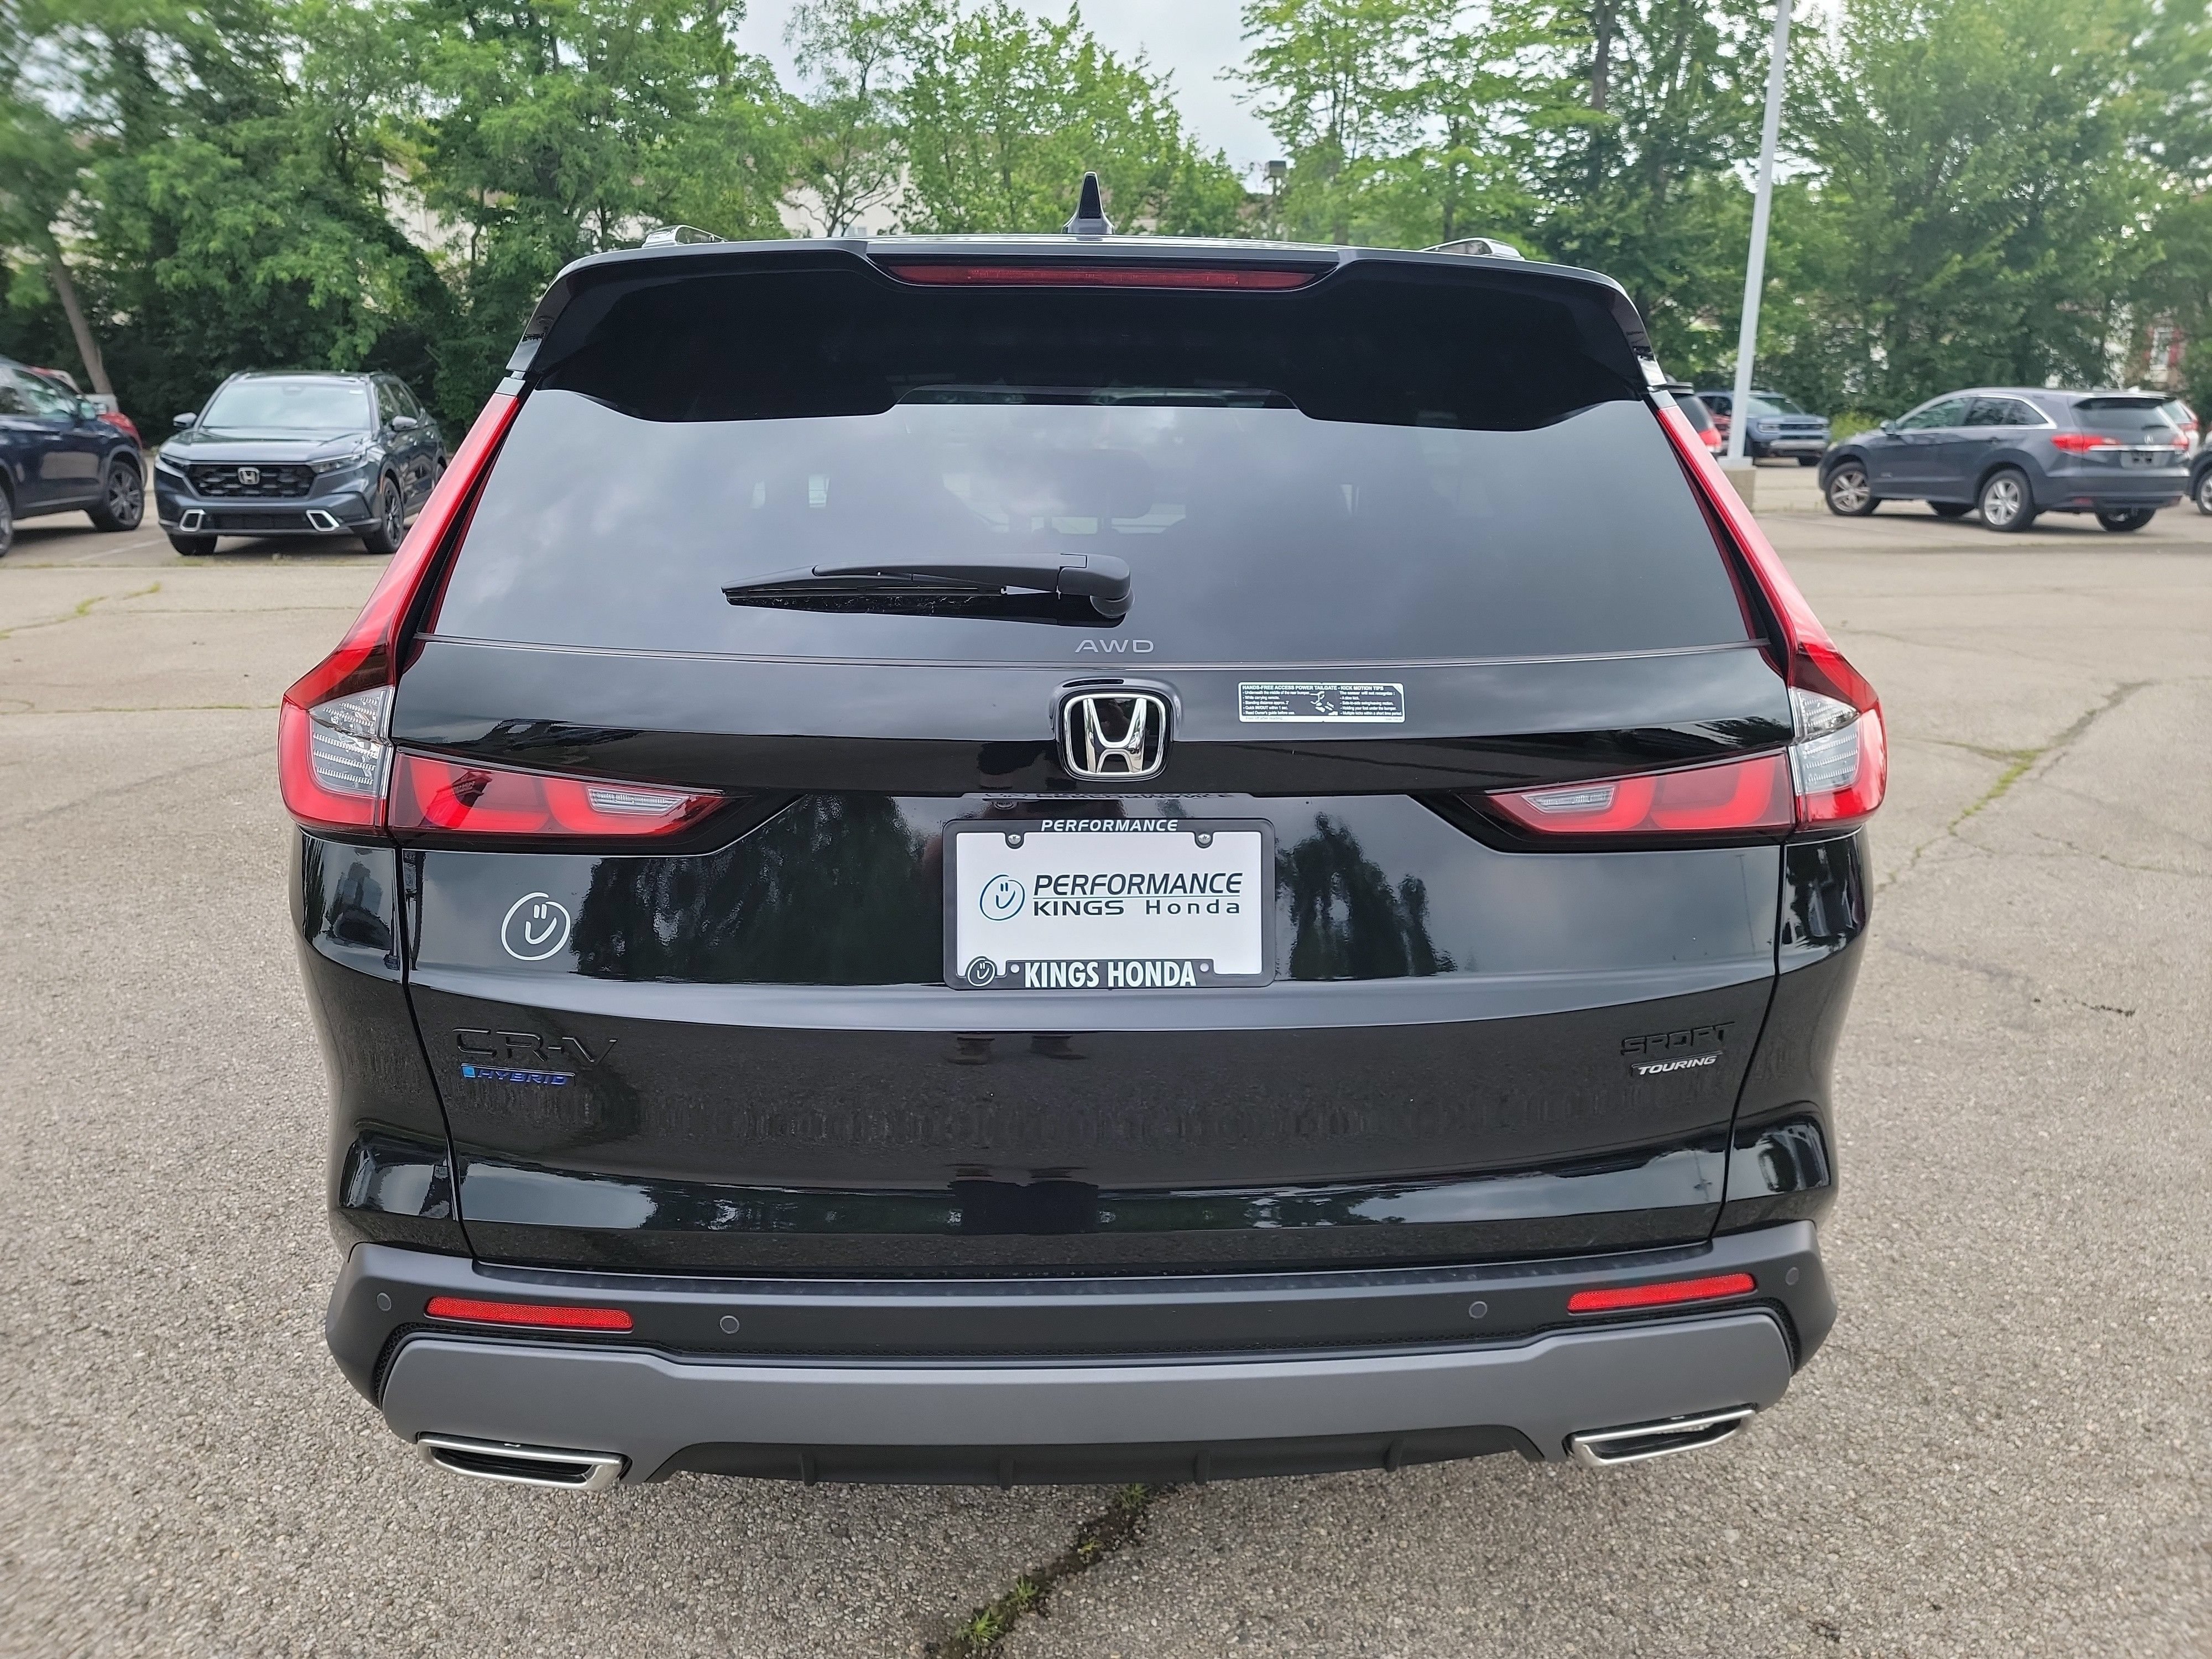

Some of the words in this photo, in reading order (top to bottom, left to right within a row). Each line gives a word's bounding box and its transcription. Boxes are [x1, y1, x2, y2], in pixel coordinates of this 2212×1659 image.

[1075, 639, 1154, 653] AWD
[1041, 819, 1178, 832] PERFORMANCE
[1034, 873, 1243, 896] PERFORMANCE
[1034, 900, 1125, 916] KINGS
[1146, 899, 1240, 915] Honda
[1024, 961, 1100, 988] KINGS
[1107, 961, 1197, 988] HONDA
[452, 1027, 618, 1063] CR-V
[1620, 1021, 1735, 1056] SPORT
[1638, 1055, 1718, 1076] TOURING
[477, 1068, 567, 1086] HYBRID
